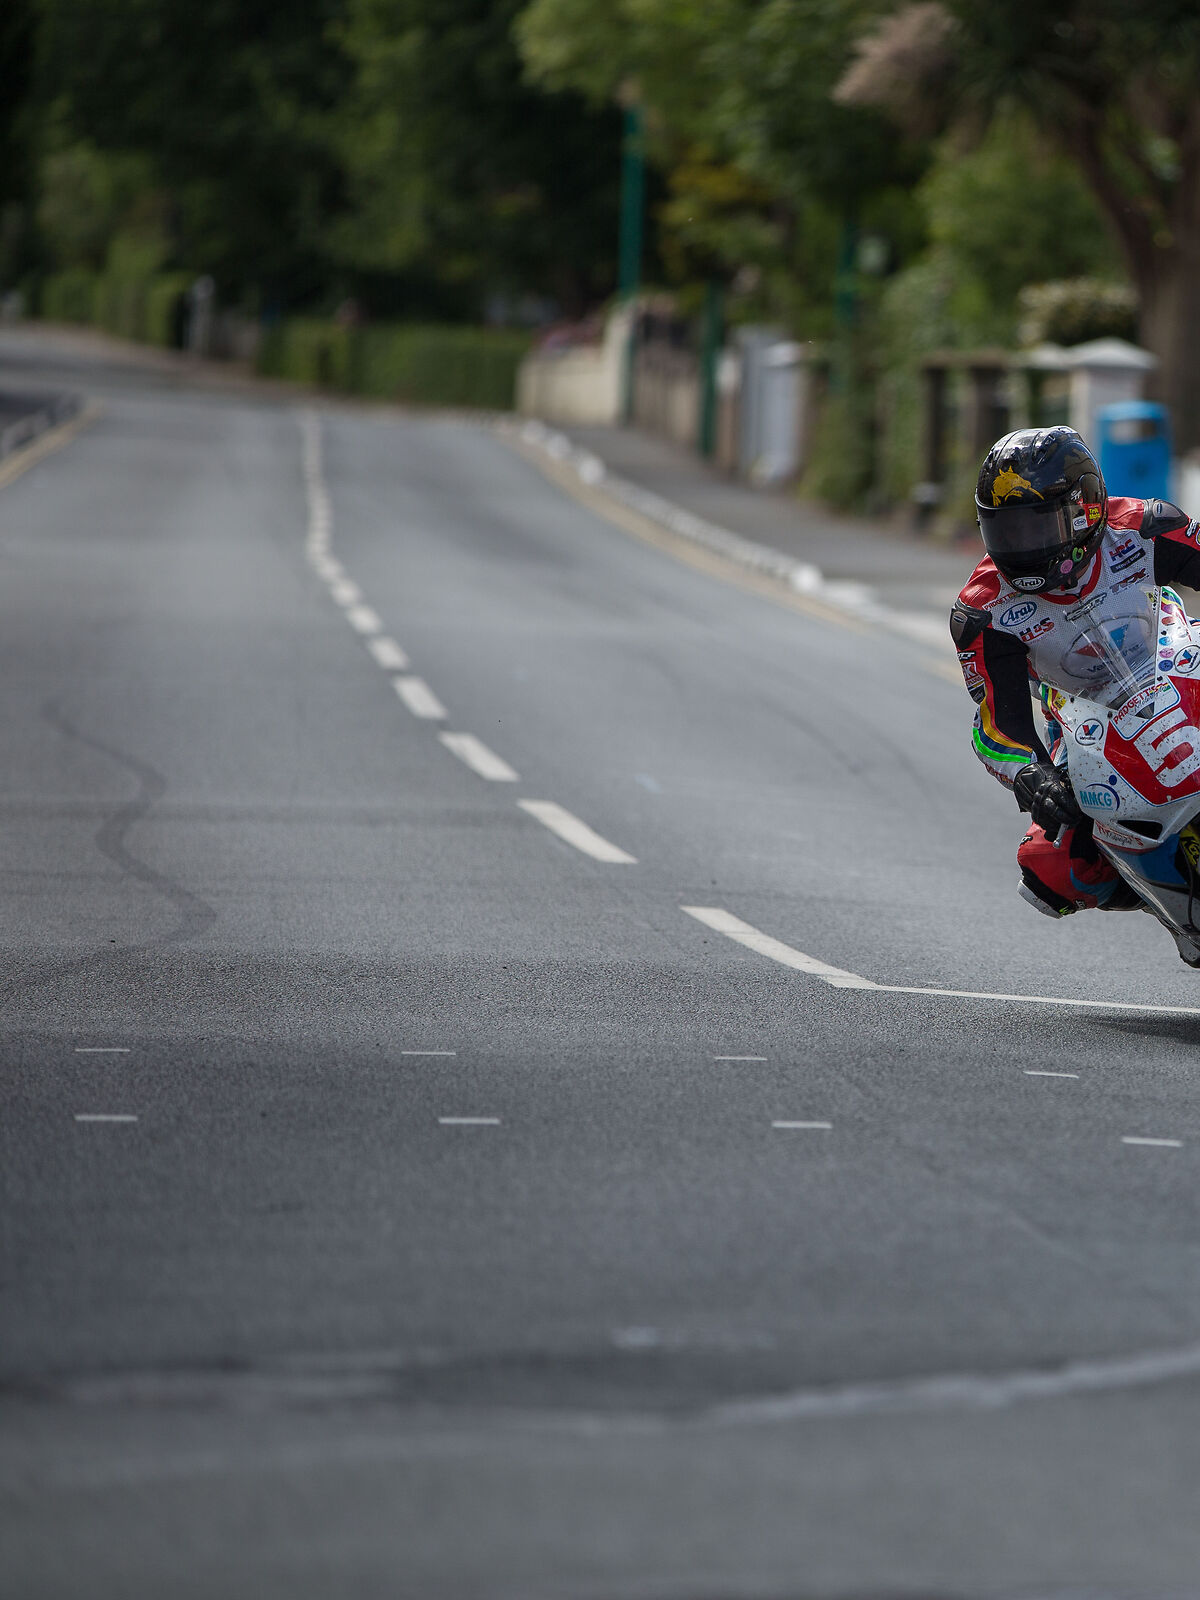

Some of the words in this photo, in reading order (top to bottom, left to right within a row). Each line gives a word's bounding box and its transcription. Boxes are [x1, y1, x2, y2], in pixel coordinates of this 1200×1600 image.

[1109, 538, 1136, 561] HRC
[1017, 577, 1040, 587] Arai
[1006, 602, 1033, 621] Arai
[1080, 790, 1113, 808] MMCG
